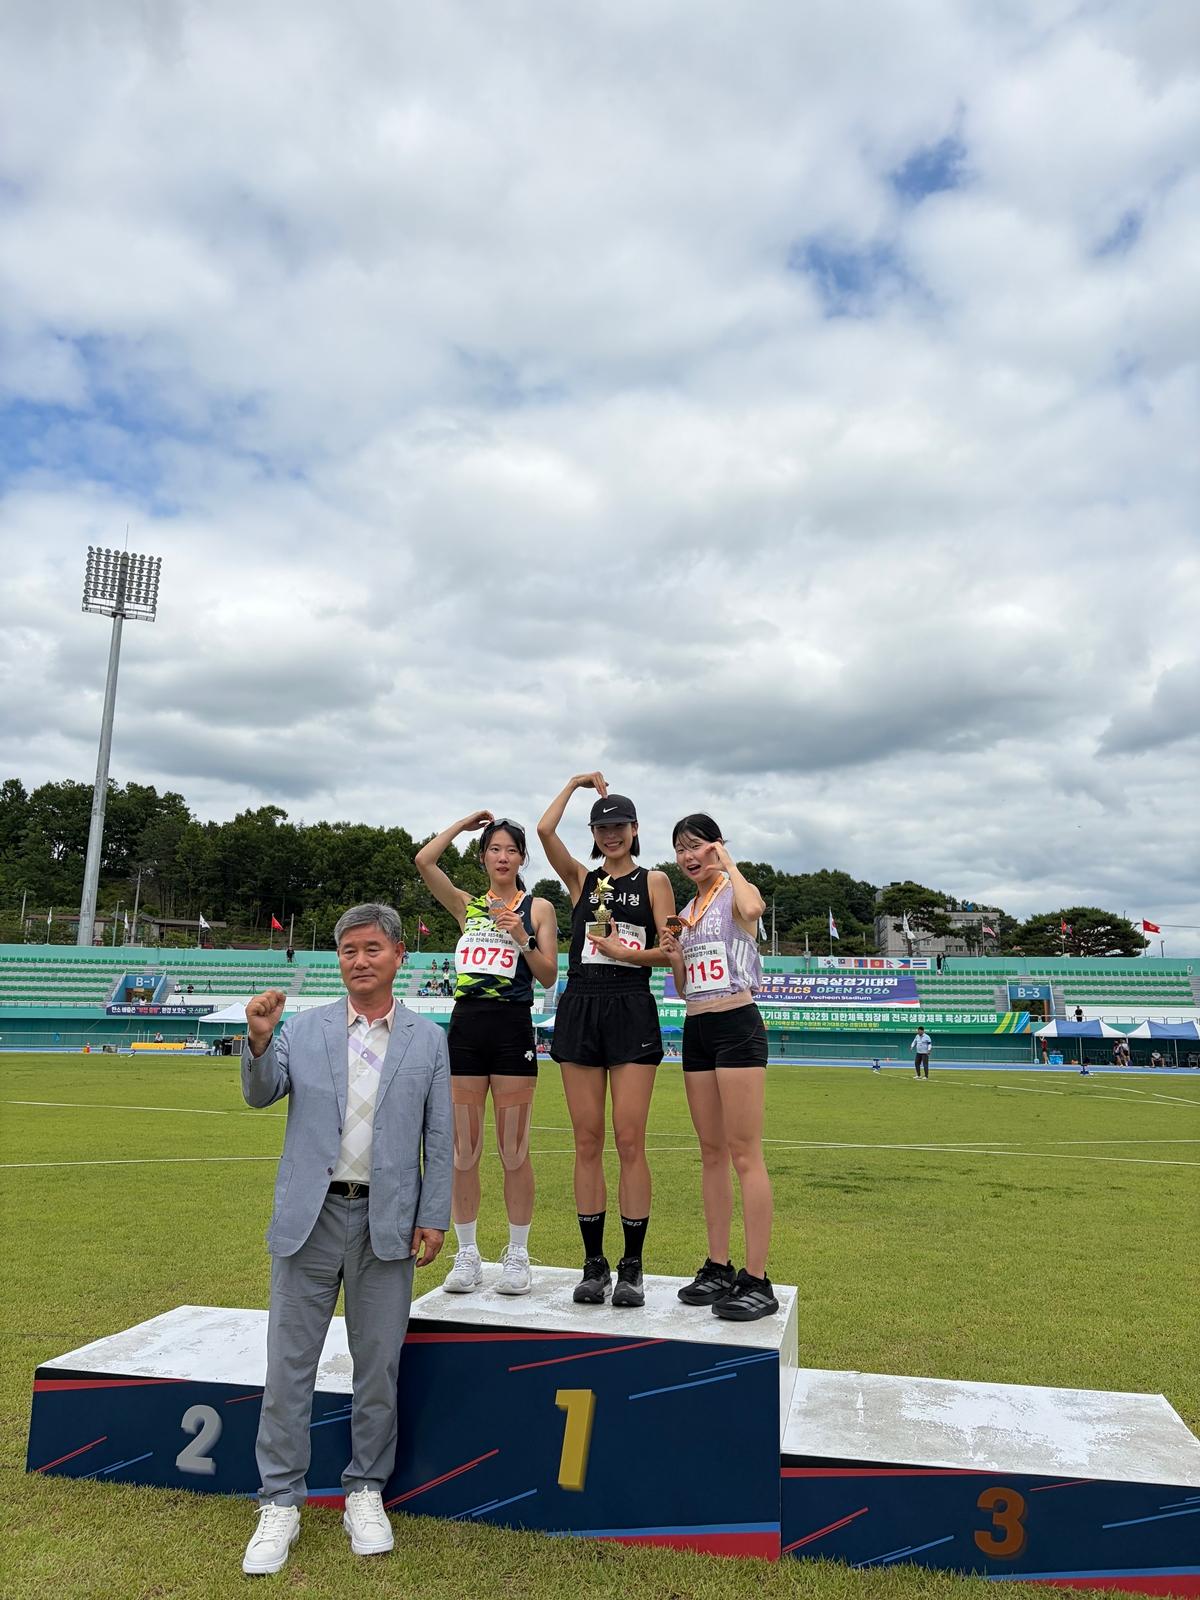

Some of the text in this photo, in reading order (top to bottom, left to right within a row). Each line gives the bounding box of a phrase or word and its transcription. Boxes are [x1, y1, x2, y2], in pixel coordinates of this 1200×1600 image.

[460, 946, 515, 969] 1075
[688, 958, 725, 984] 115
[135, 977, 155, 987] B-1
[789, 976, 898, 987] 국제육상경기대회
[855, 987, 890, 995] 2026
[1017, 987, 1040, 998] B-3
[658, 1009, 678, 1018] AF배
[802, 1012, 829, 1021] 제32회
[831, 1012, 890, 1022] 대한체육회장배
[892, 1013, 943, 1023] 전국생활체육
[945, 1013, 998, 1023] 육상경기대회
[175, 1404, 223, 1476] 2
[555, 1388, 597, 1492] 1
[974, 1486, 1028, 1559] 3
